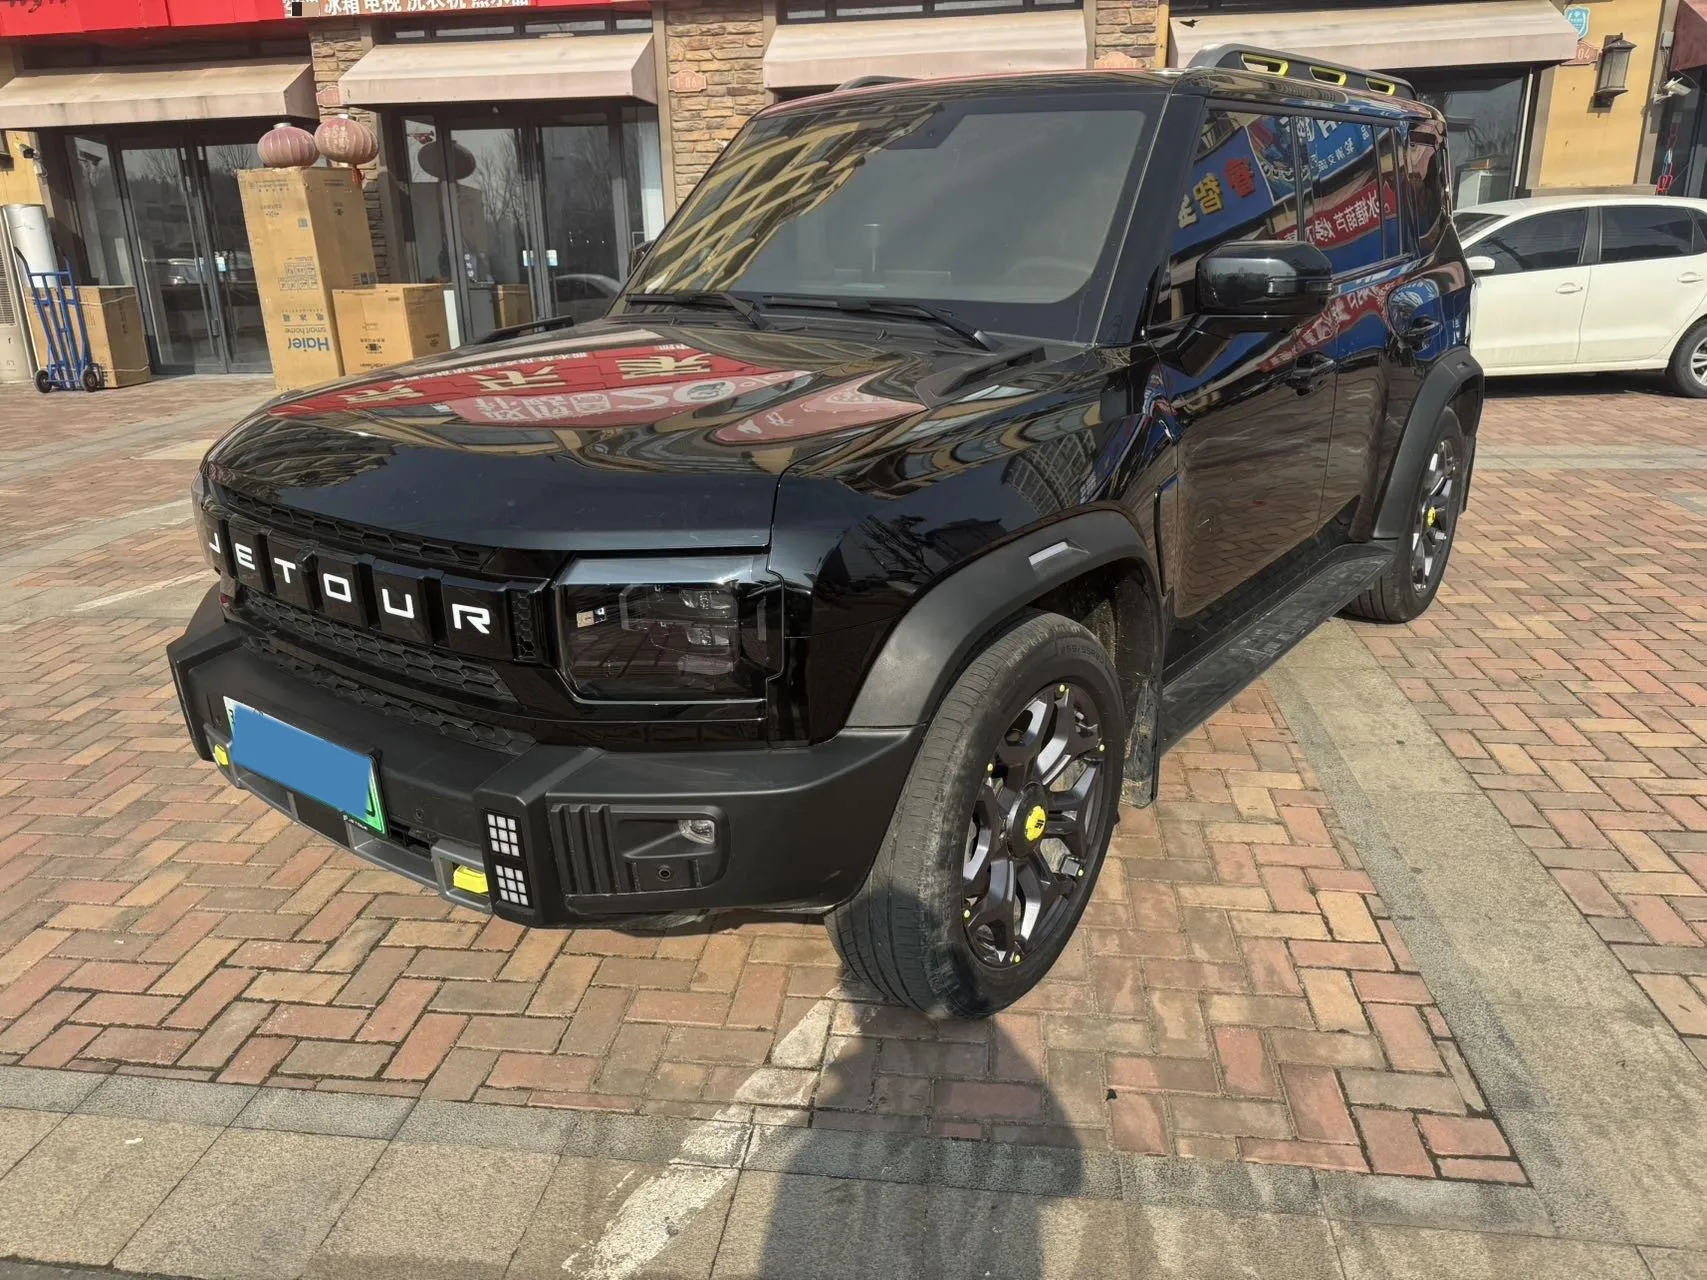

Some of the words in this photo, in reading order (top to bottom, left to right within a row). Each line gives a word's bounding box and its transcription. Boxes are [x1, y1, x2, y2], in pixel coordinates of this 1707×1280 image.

[325, 0, 360, 15] 冰箱
[287, 337, 330, 352] Haier
[208, 532, 491, 635] JETOUR
